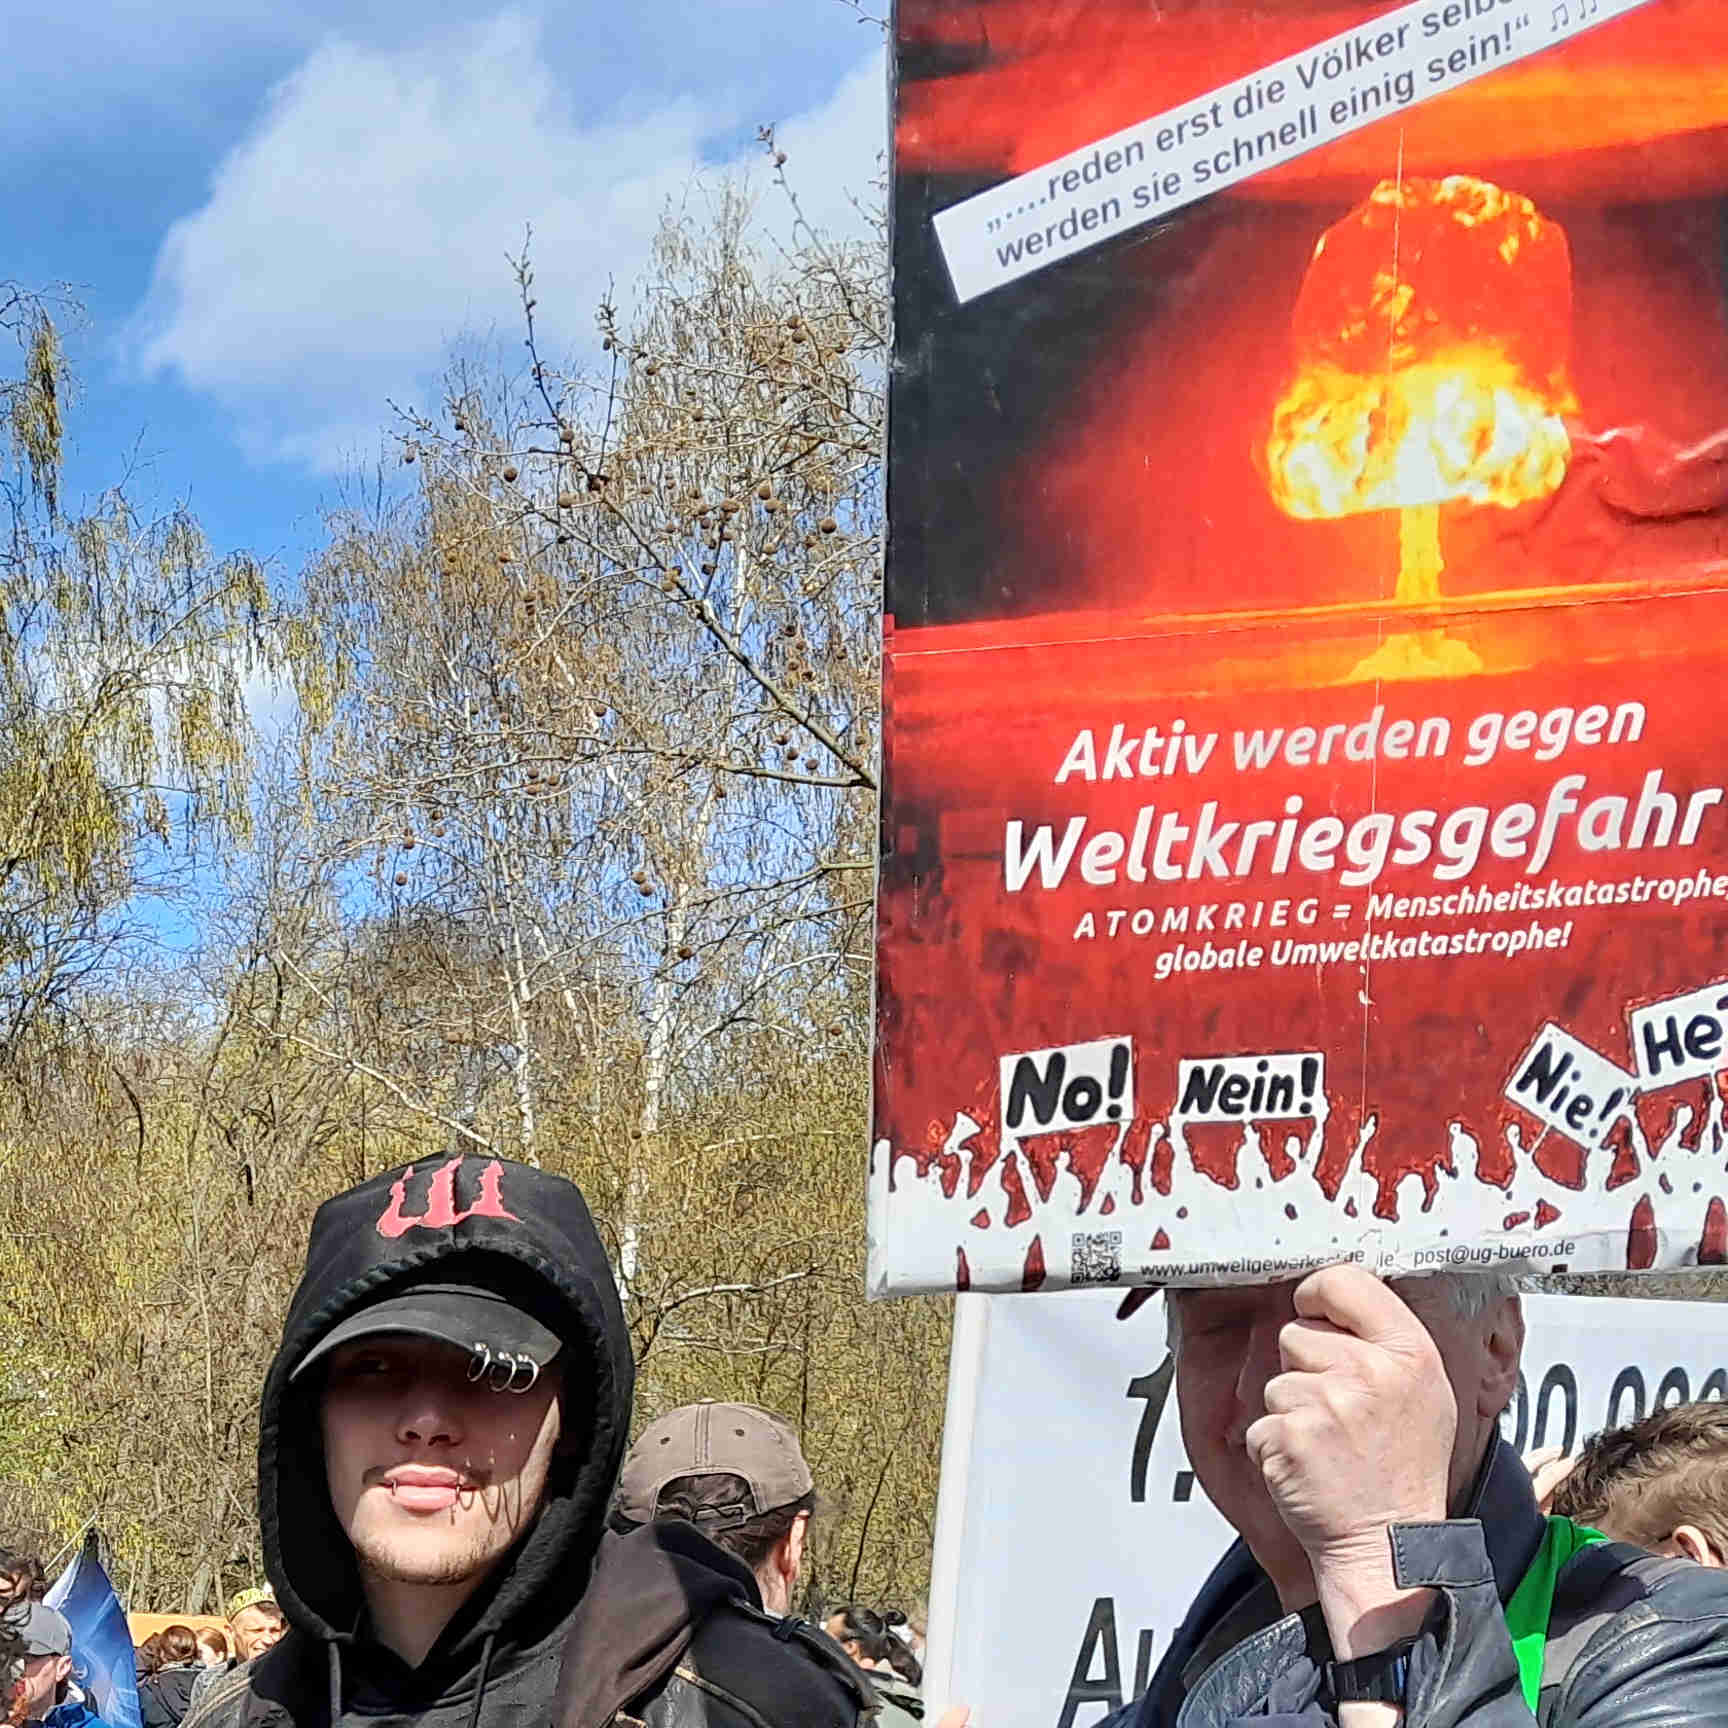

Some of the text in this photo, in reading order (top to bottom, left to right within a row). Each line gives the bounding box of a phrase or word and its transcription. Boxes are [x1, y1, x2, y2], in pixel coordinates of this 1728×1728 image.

[1155, 104, 1224, 153] erst
[1232, 79, 1286, 121] die
[1295, 23, 1410, 92] Völker
[996, 197, 1121, 267] werden
[1132, 171, 1183, 210] sie
[1191, 104, 1319, 184] schnell
[1328, 71, 1415, 127] einig
[1054, 700, 1647, 785] Aktiv werden gegen
[1002, 769, 1725, 894] Weltkriegsgefahr
[1154, 920, 1573, 981] globale Umweltkatastrophe!
[1005, 1041, 1131, 1131] No!
[1178, 1056, 1318, 1116] Nein!
[1518, 1051, 1629, 1138] Nie!
[1413, 1239, 1576, 1267] post@ug-buero.de
